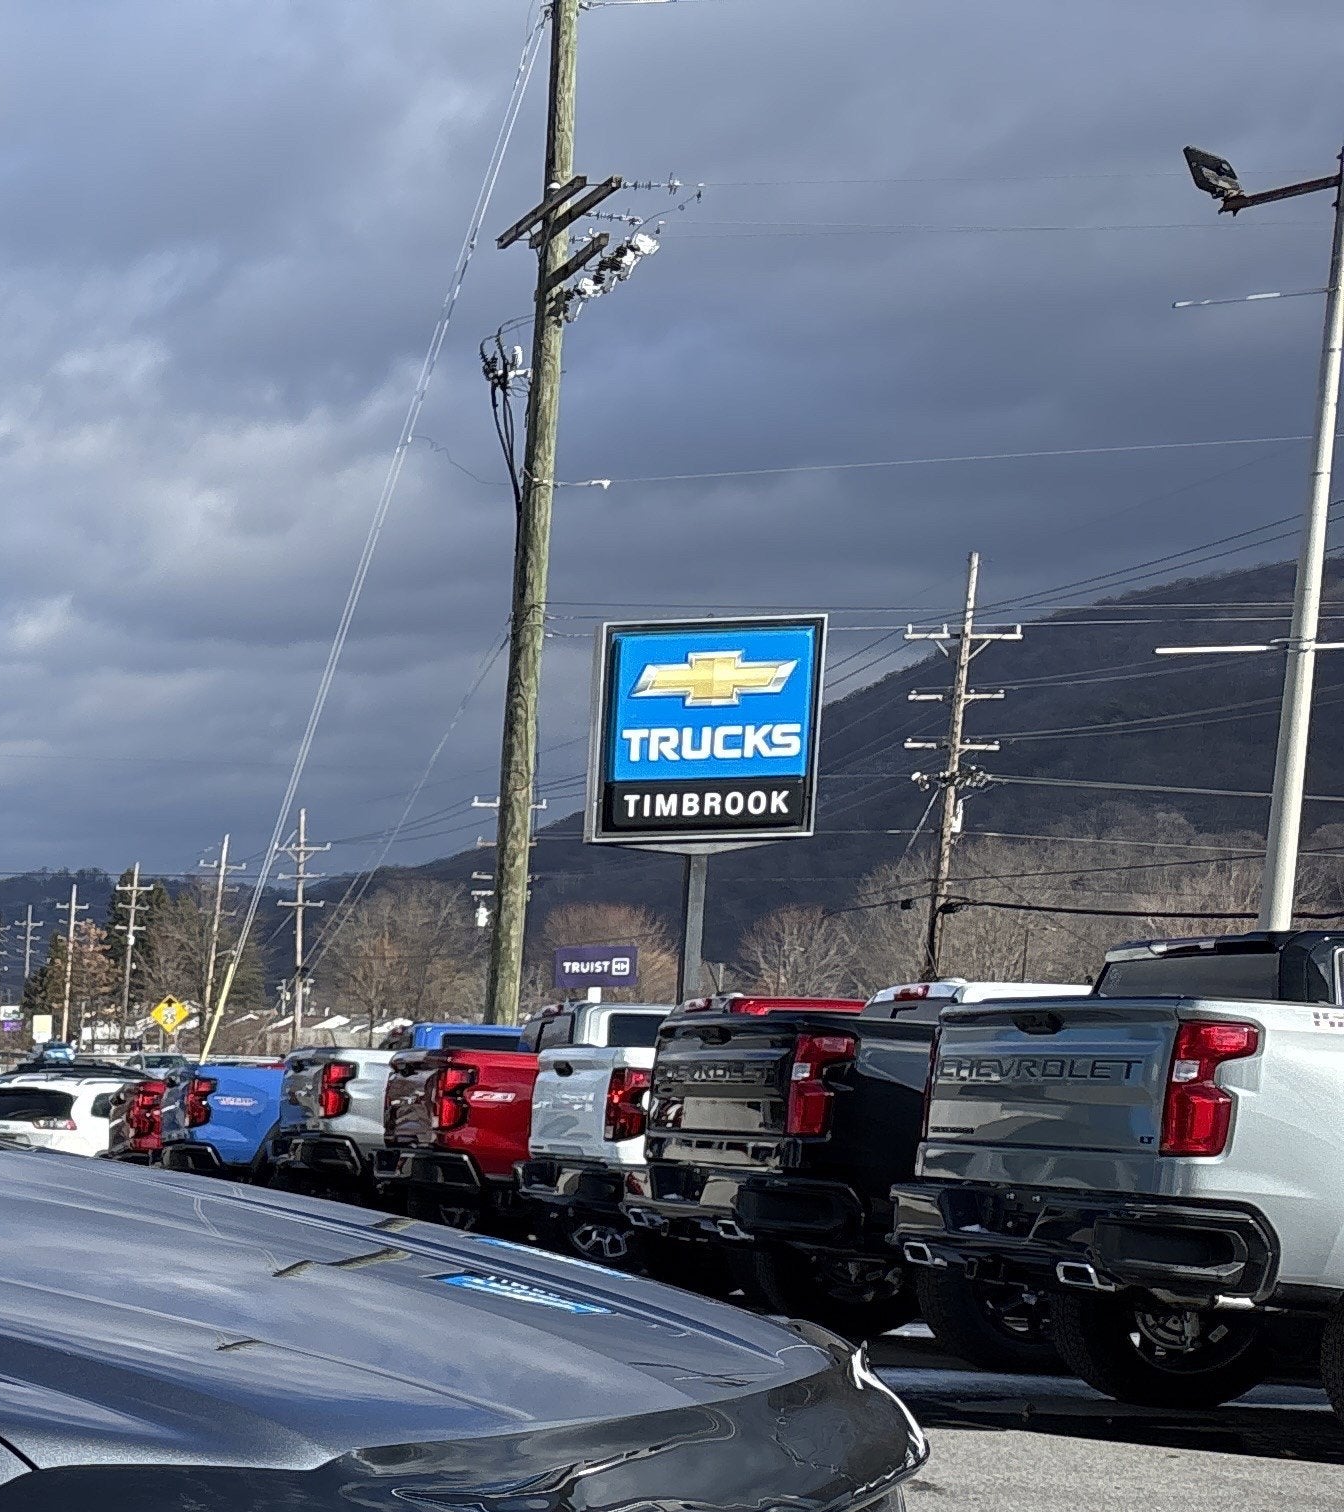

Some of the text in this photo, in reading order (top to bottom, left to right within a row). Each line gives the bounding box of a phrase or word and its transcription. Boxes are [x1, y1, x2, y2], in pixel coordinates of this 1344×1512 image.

[622, 723, 802, 762] TRUCKS
[623, 790, 789, 818] TIMBROOK
[562, 960, 611, 974] TRUIST
[938, 1057, 1143, 1081] CHEVROLET
